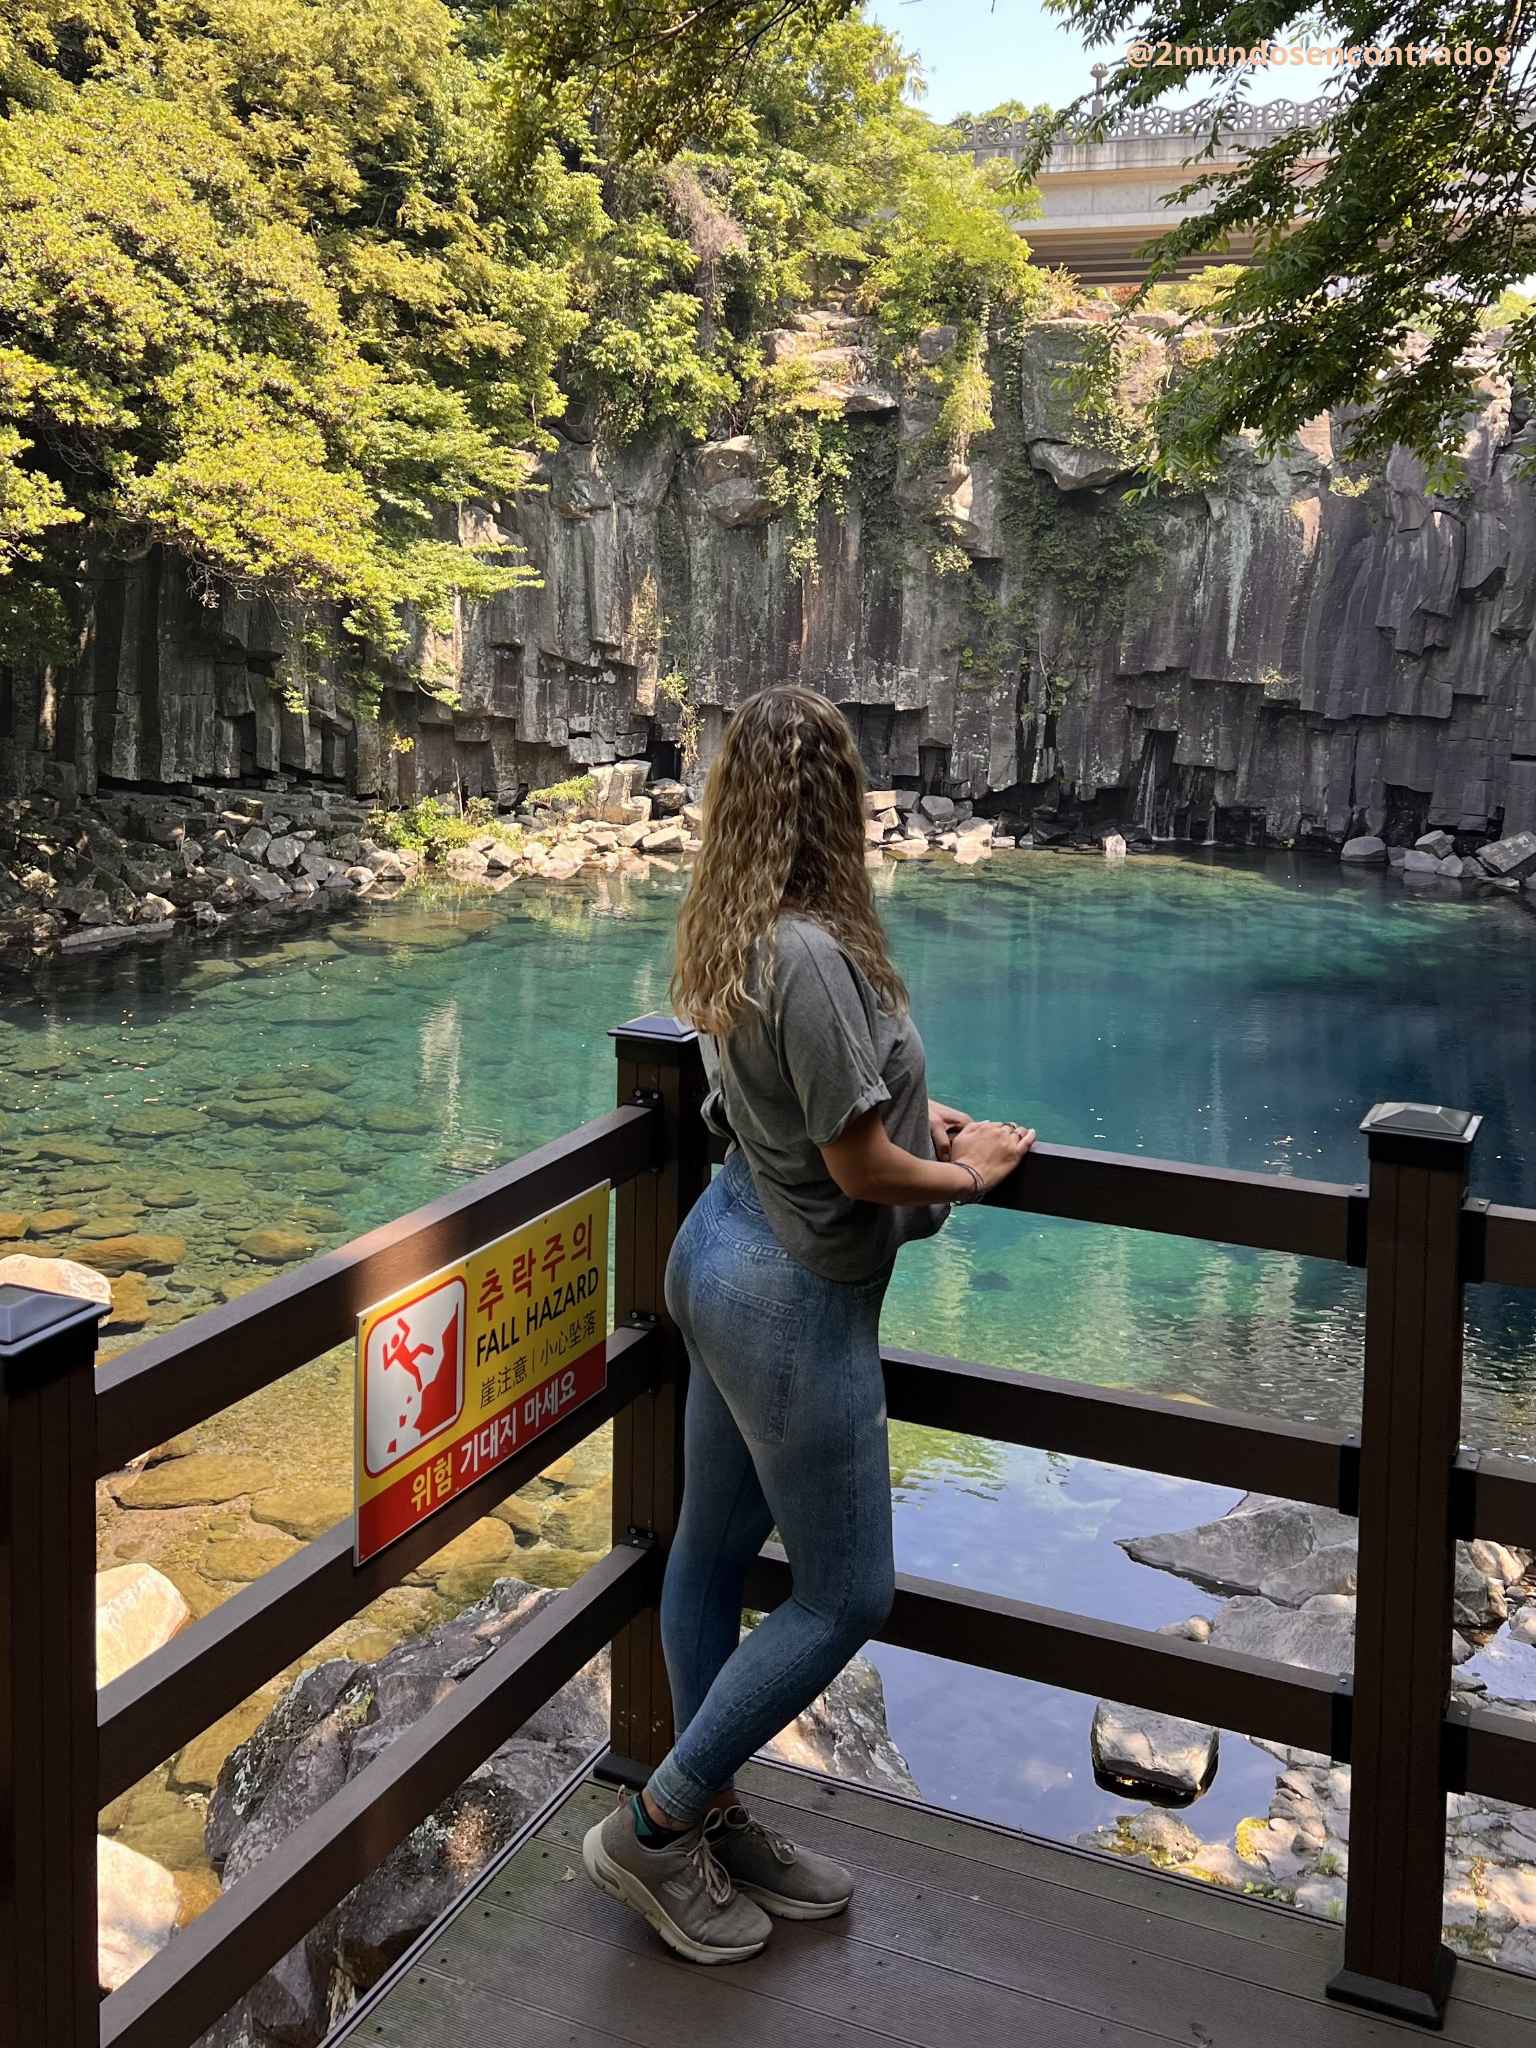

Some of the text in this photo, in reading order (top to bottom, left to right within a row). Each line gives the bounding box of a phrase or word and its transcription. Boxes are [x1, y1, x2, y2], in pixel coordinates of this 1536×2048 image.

[477, 1213, 592, 1321] 추락주의
[477, 1267, 599, 1367] FALL HAZARD
[411, 1371, 577, 1512] 위험 기대지 마세요
